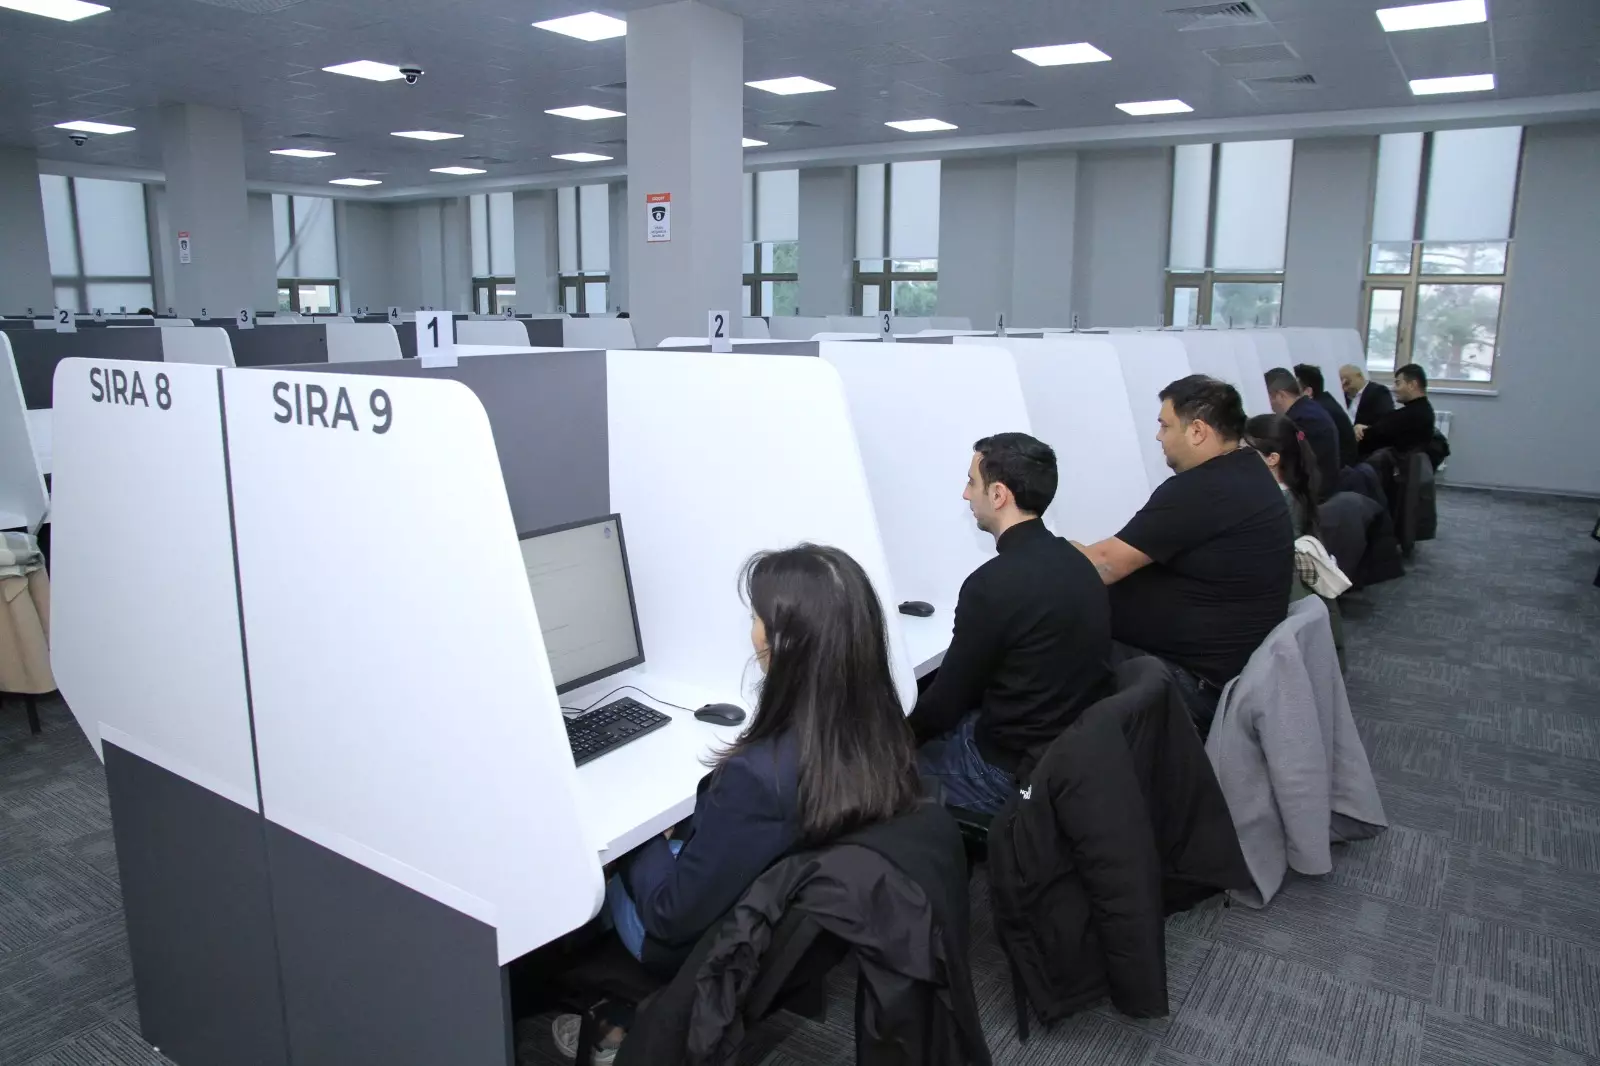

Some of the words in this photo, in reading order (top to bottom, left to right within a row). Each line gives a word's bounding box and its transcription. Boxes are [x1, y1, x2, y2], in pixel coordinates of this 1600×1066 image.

[59, 310, 70, 324] 2
[95, 309, 102, 317] 4
[201, 307, 207, 316] 5
[240, 310, 249, 323] 3
[391, 307, 398, 319] 4
[507, 307, 513, 318] 5
[714, 314, 724, 338] 2
[883, 313, 890, 333] 3
[998, 313, 1004, 330] 4
[427, 316, 439, 348] 1
[89, 367, 150, 408] SIRA
[155, 372, 172, 411] 8
[272, 381, 360, 431] SIRA
[369, 388, 393, 435] 9
